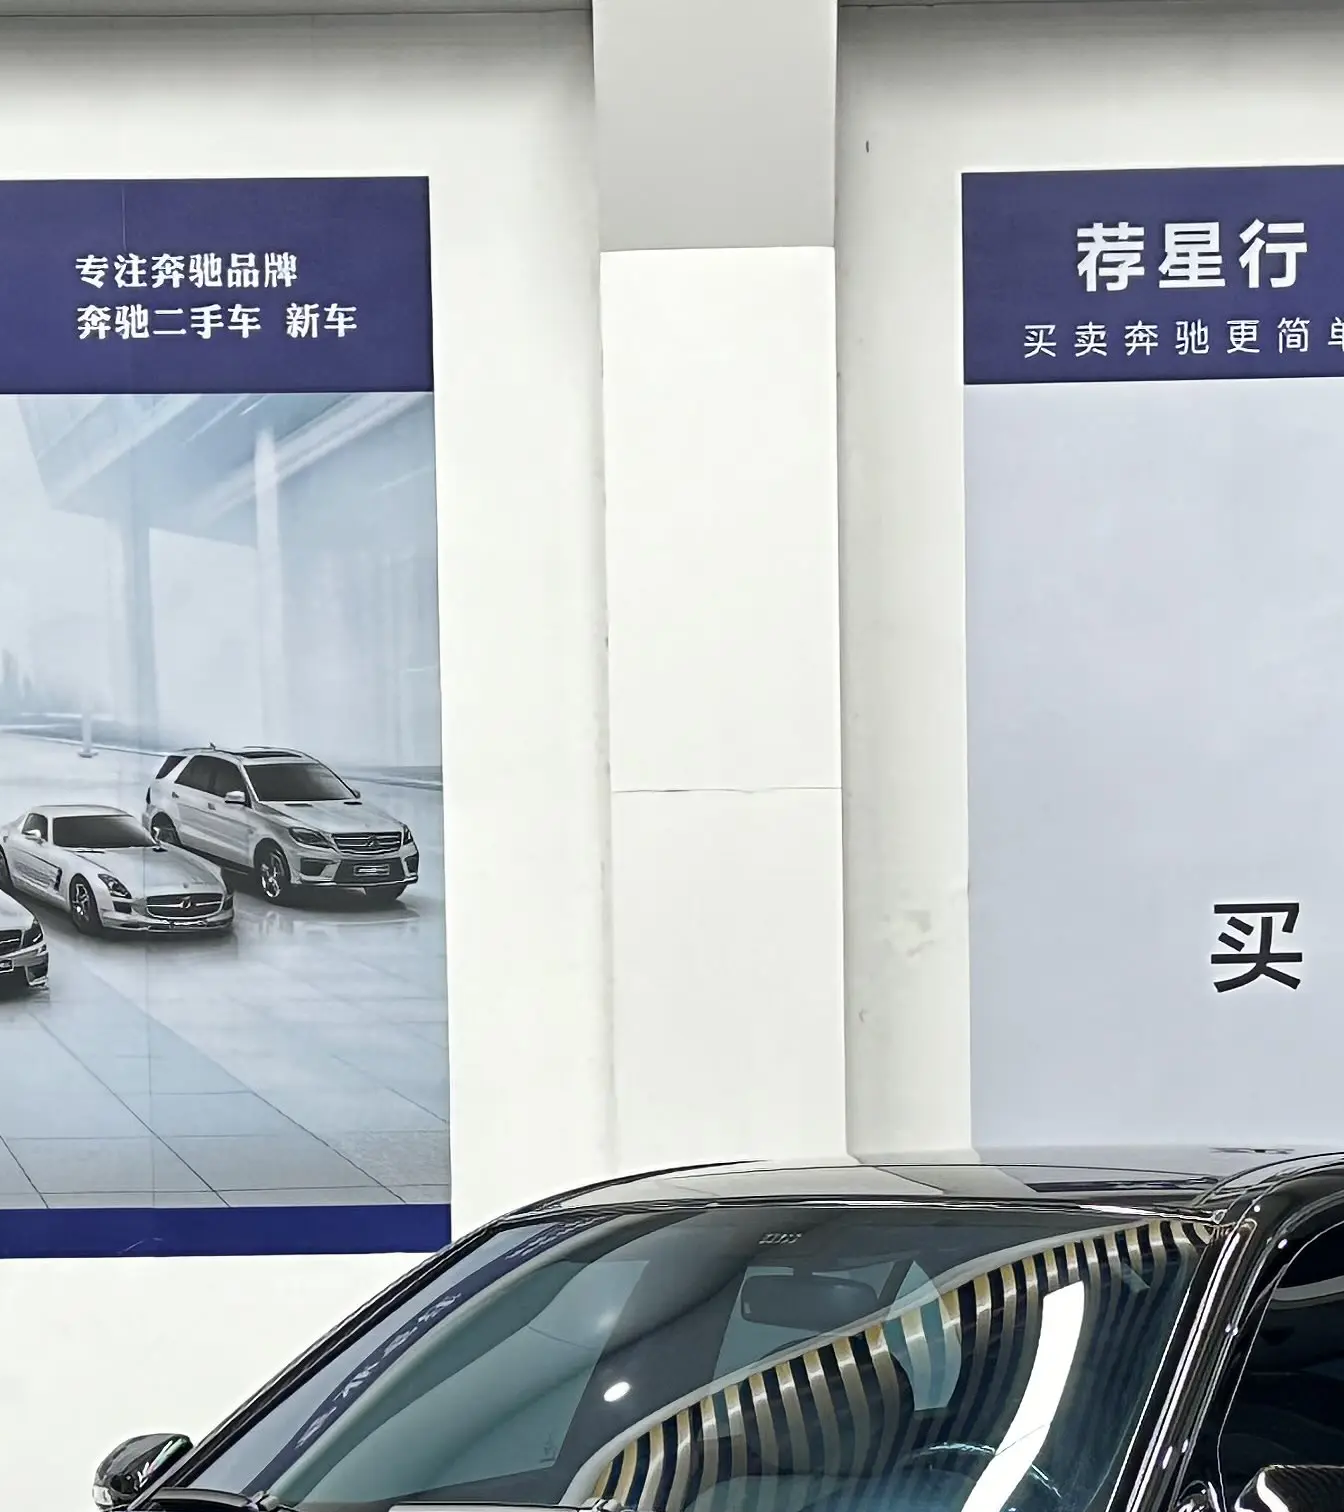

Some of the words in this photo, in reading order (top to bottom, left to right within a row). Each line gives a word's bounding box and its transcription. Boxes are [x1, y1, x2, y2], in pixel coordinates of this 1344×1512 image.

[75, 252, 298, 289] 专注奔驰品牌
[1076, 218, 1308, 292] 荐星行
[76, 303, 262, 340] 奔驰二手车
[286, 302, 358, 339] 新车
